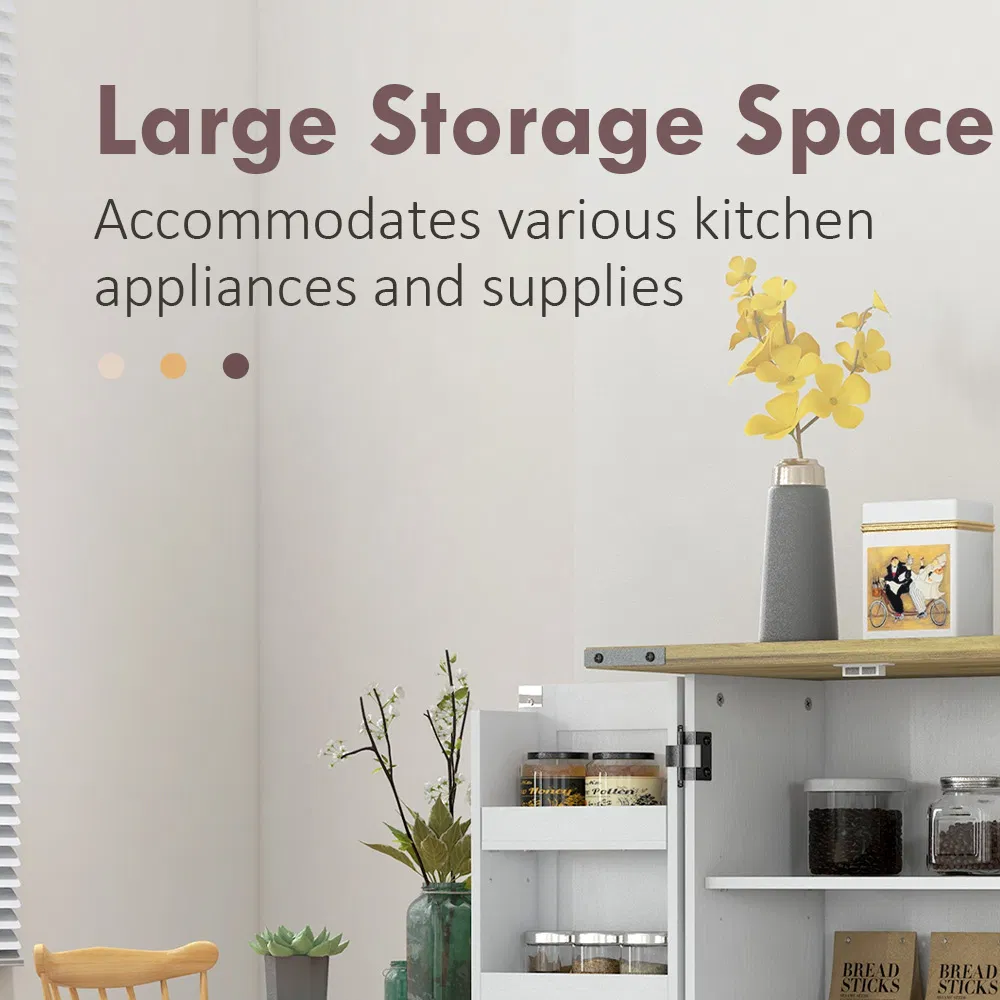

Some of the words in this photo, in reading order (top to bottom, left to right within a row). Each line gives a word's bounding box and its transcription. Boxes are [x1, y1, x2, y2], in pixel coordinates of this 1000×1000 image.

[842, 962, 900, 978] BREAD
[939, 963, 998, 979] BREAD
[840, 977, 900, 993] STICKS
[937, 979, 998, 995] STICKS
